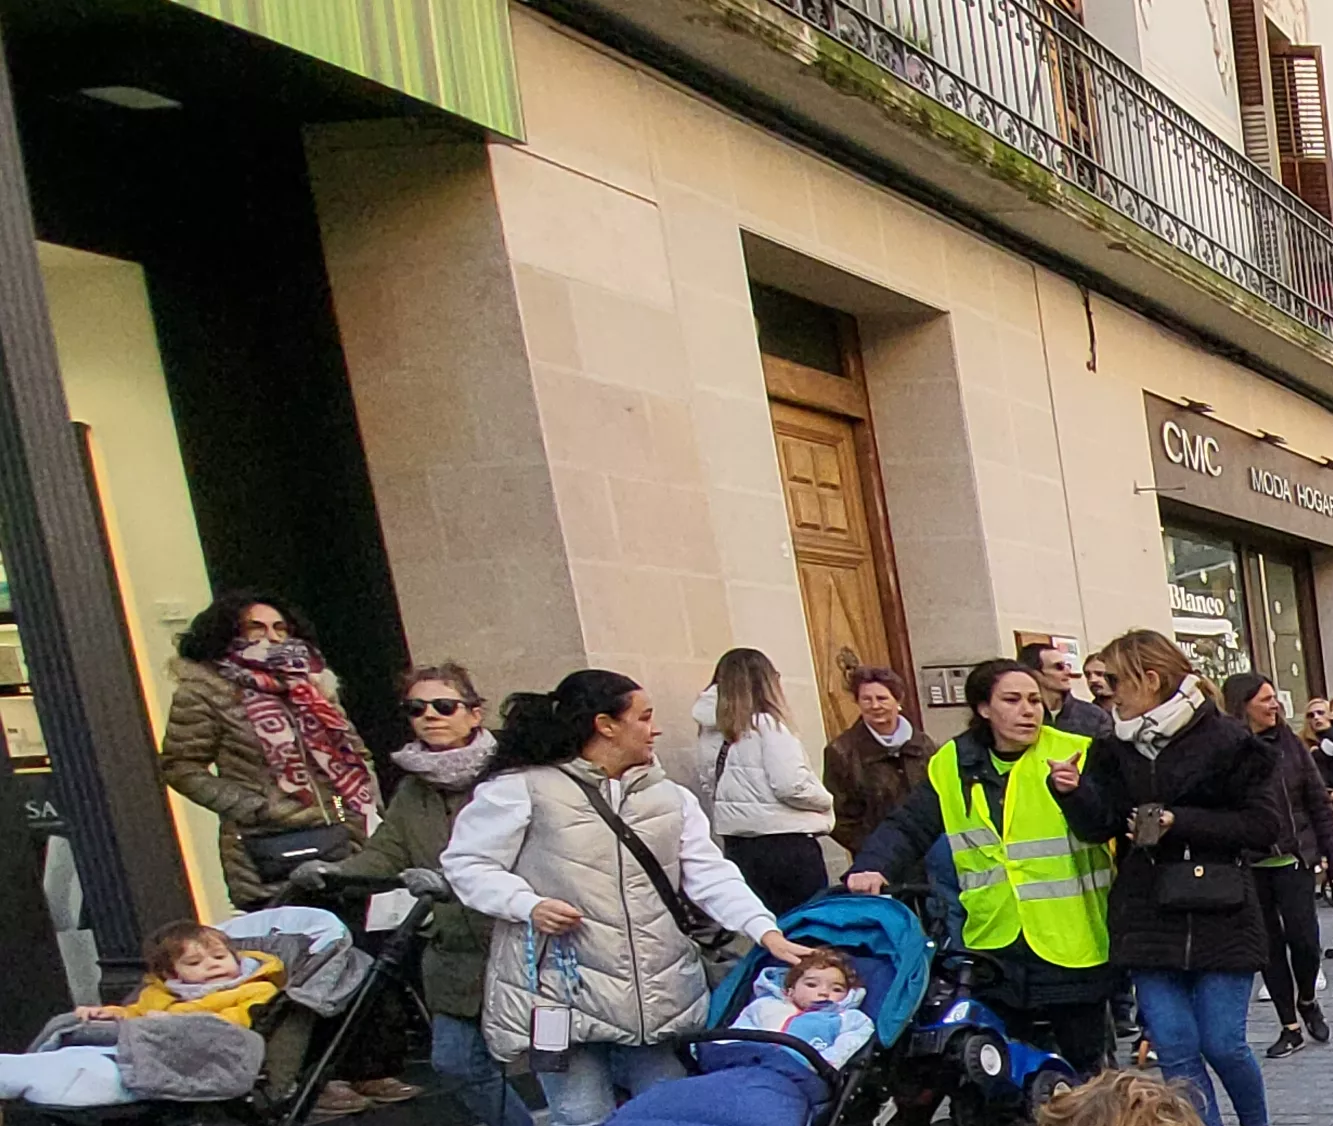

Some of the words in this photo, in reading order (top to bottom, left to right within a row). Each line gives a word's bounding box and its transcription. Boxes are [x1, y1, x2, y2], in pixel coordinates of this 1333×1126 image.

[1162, 421, 1222, 477] CMC
[1250, 467, 1292, 504] MODA
[1168, 583, 1224, 616] Blanco
